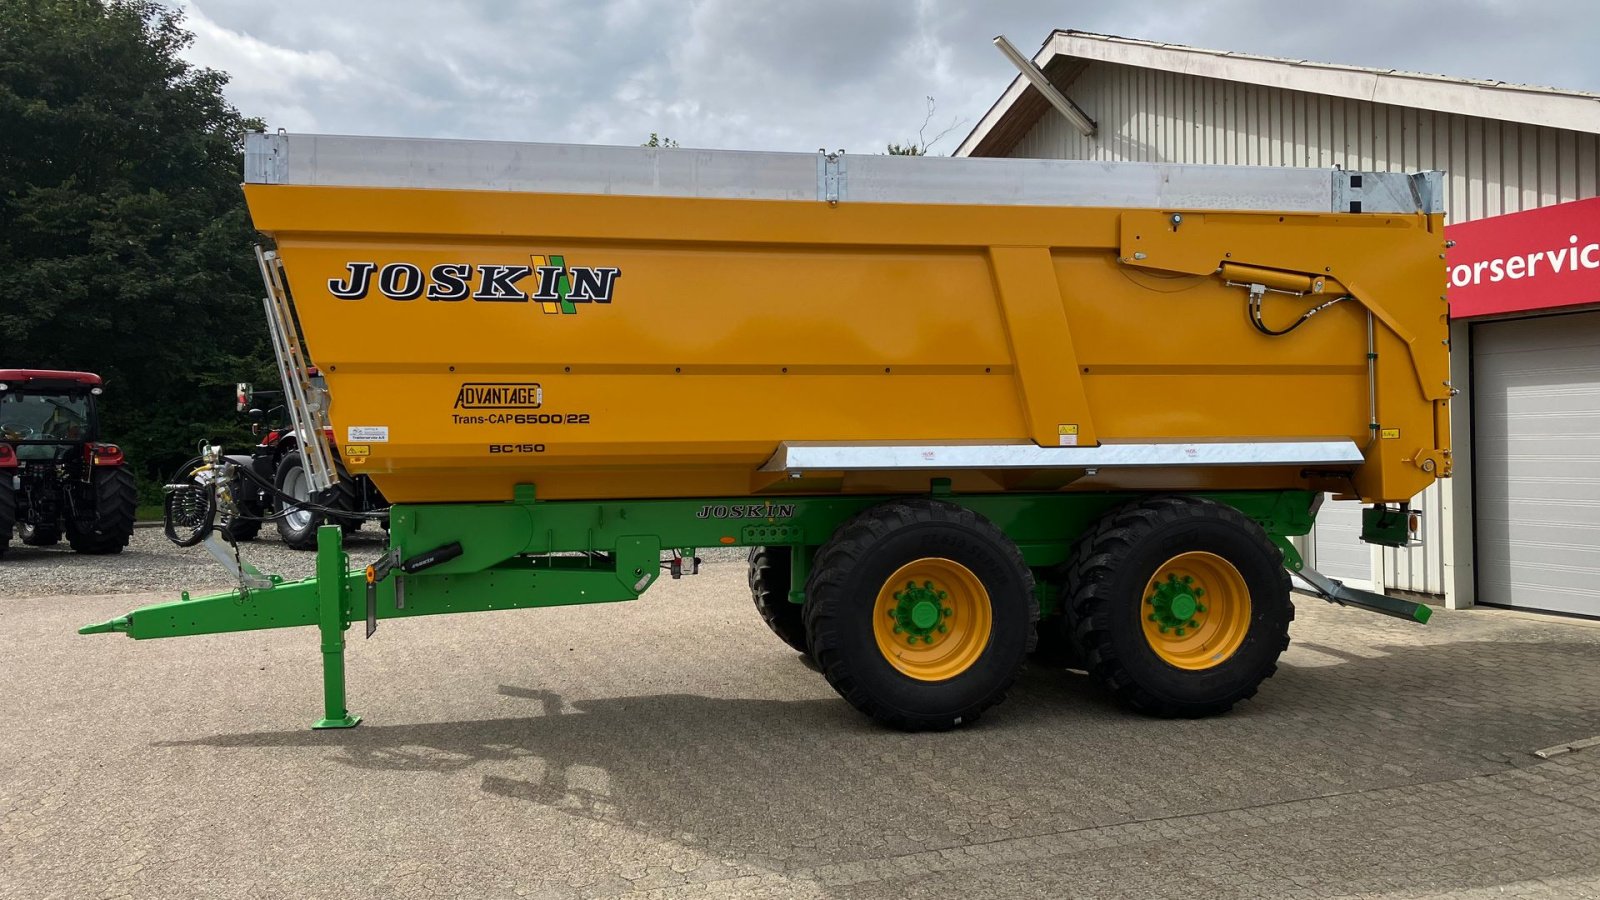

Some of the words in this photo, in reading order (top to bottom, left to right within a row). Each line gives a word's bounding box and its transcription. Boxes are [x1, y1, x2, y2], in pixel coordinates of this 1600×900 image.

[327, 262, 621, 303] JOSKIN
[453, 387, 535, 409] ADVANTAGE
[696, 504, 795, 519] JOSKIN
